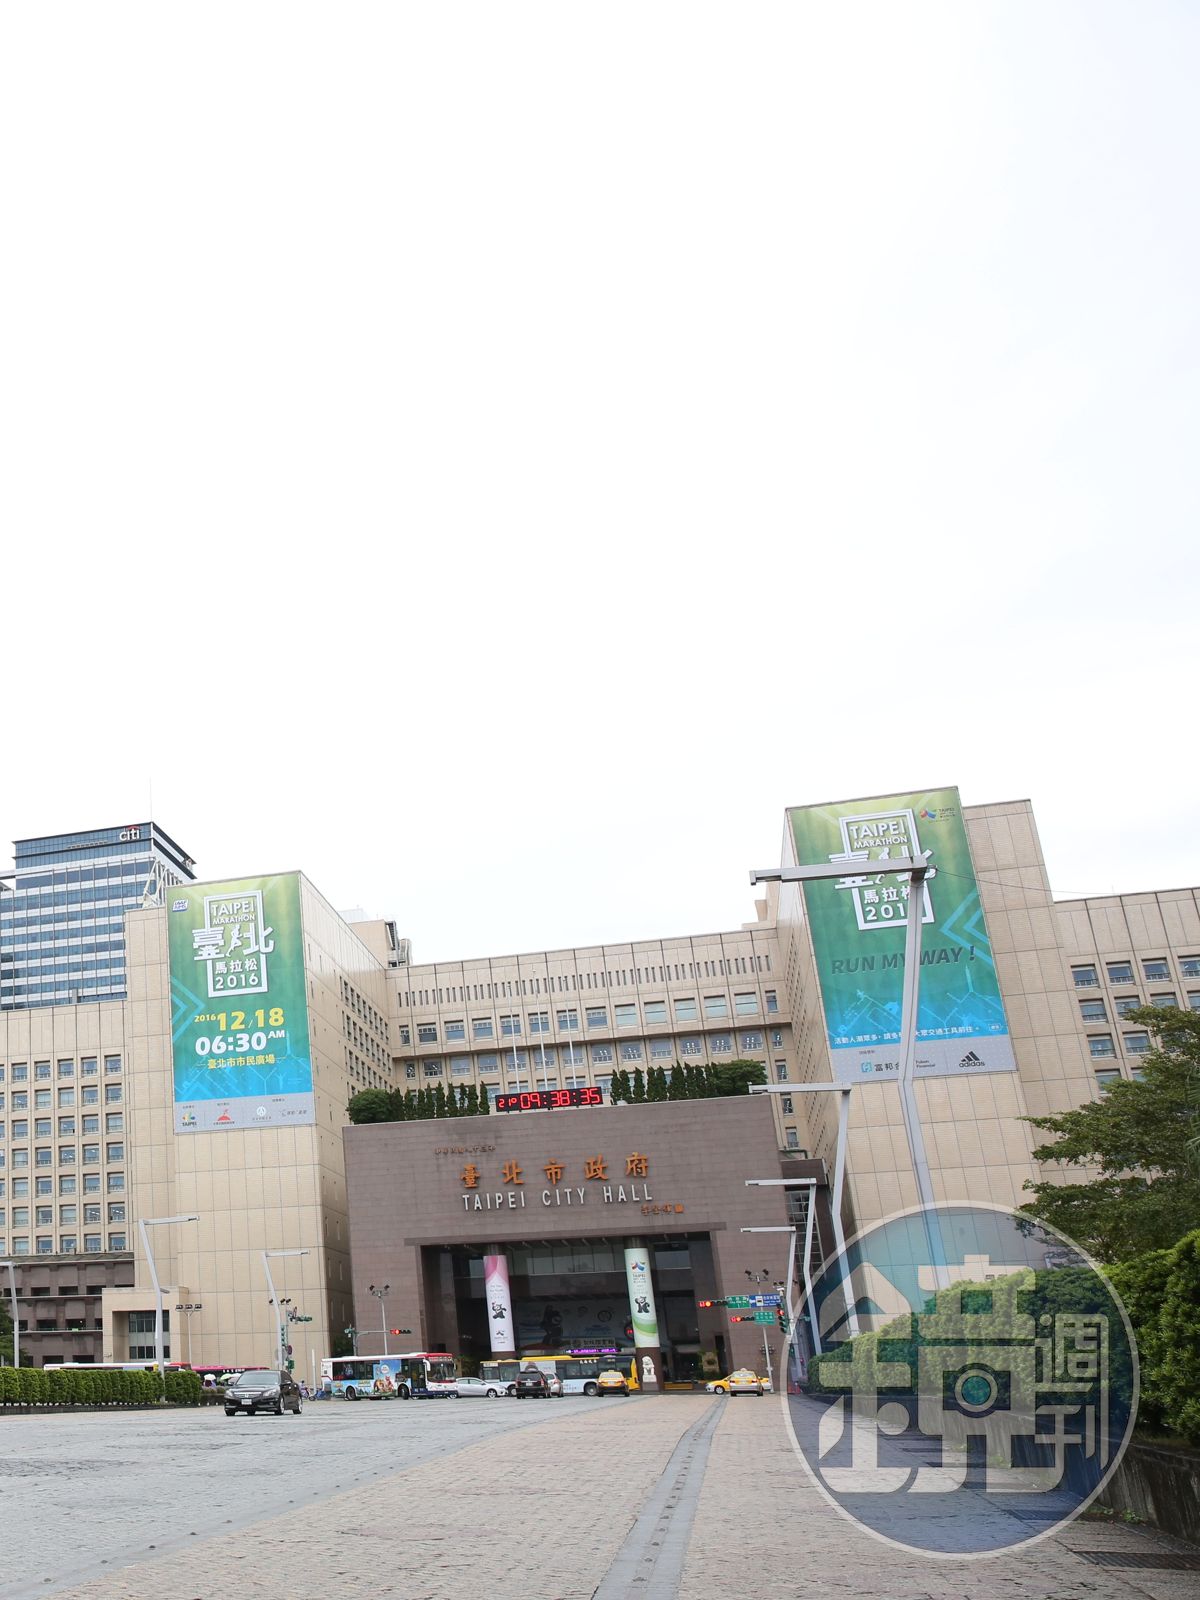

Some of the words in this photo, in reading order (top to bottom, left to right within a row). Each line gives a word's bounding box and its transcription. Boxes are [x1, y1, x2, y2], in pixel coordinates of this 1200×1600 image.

[850, 818, 905, 839] TAIPEI
[854, 836, 908, 849] MARATHON
[211, 900, 254, 916] TAIPEI
[865, 903, 905, 920] 201
[212, 914, 255, 925] MARATHON
[192, 922, 274, 960] 臺北
[215, 958, 258, 974] 馬拉松
[831, 956, 875, 975] RUN
[215, 973, 258, 989] 2016
[194, 1014, 217, 1023] 2016
[217, 1007, 284, 1031] 12/18
[195, 1031, 267, 1056] 06:30
[267, 1030, 285, 1039] AM
[958, 1060, 986, 1069] adidas
[520, 1087, 601, 1109] 09:38:35
[460, 1151, 650, 1189] 臺北市政府
[462, 1191, 526, 1211] TAIPEI
[542, 1187, 586, 1206] CITY
[602, 1184, 653, 1203] HALL
